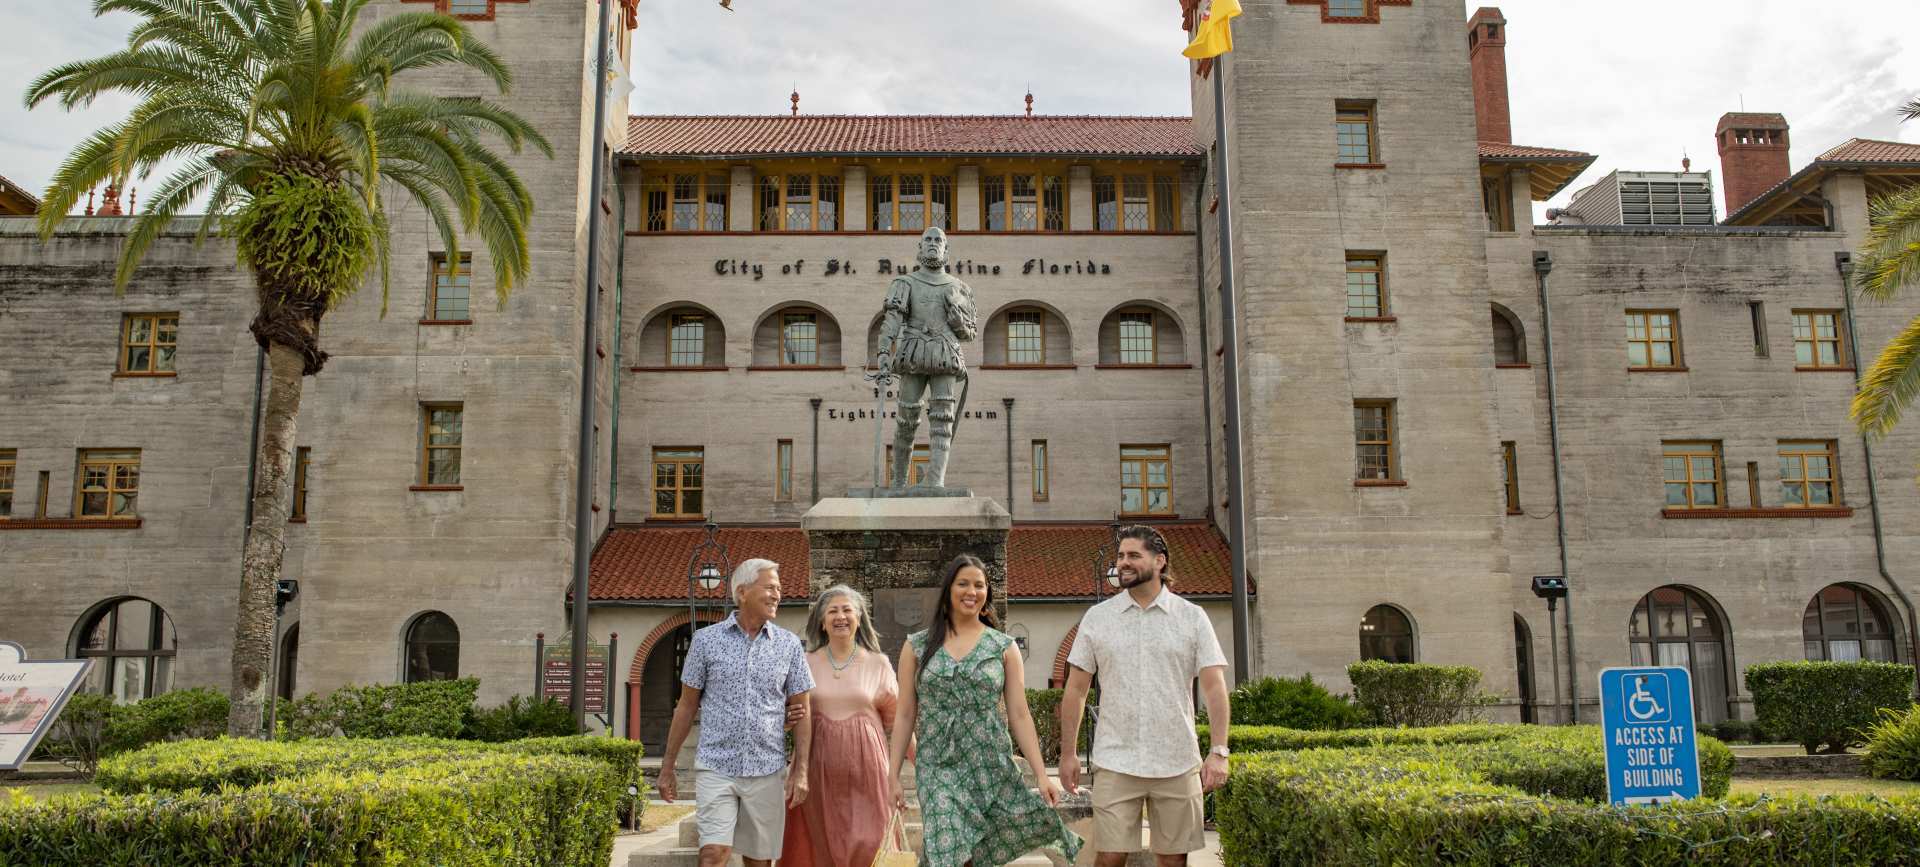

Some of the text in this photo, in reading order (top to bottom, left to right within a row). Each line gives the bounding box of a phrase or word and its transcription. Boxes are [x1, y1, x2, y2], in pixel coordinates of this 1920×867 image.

[714, 259, 763, 281] City
[782, 259, 804, 275] of
[824, 258, 857, 277] St.
[1022, 258, 1111, 275] Florida
[1615, 726, 1684, 746] ACCESS AT
[1627, 747, 1675, 767] SIDE OF
[1623, 768, 1684, 788] BUILDING
